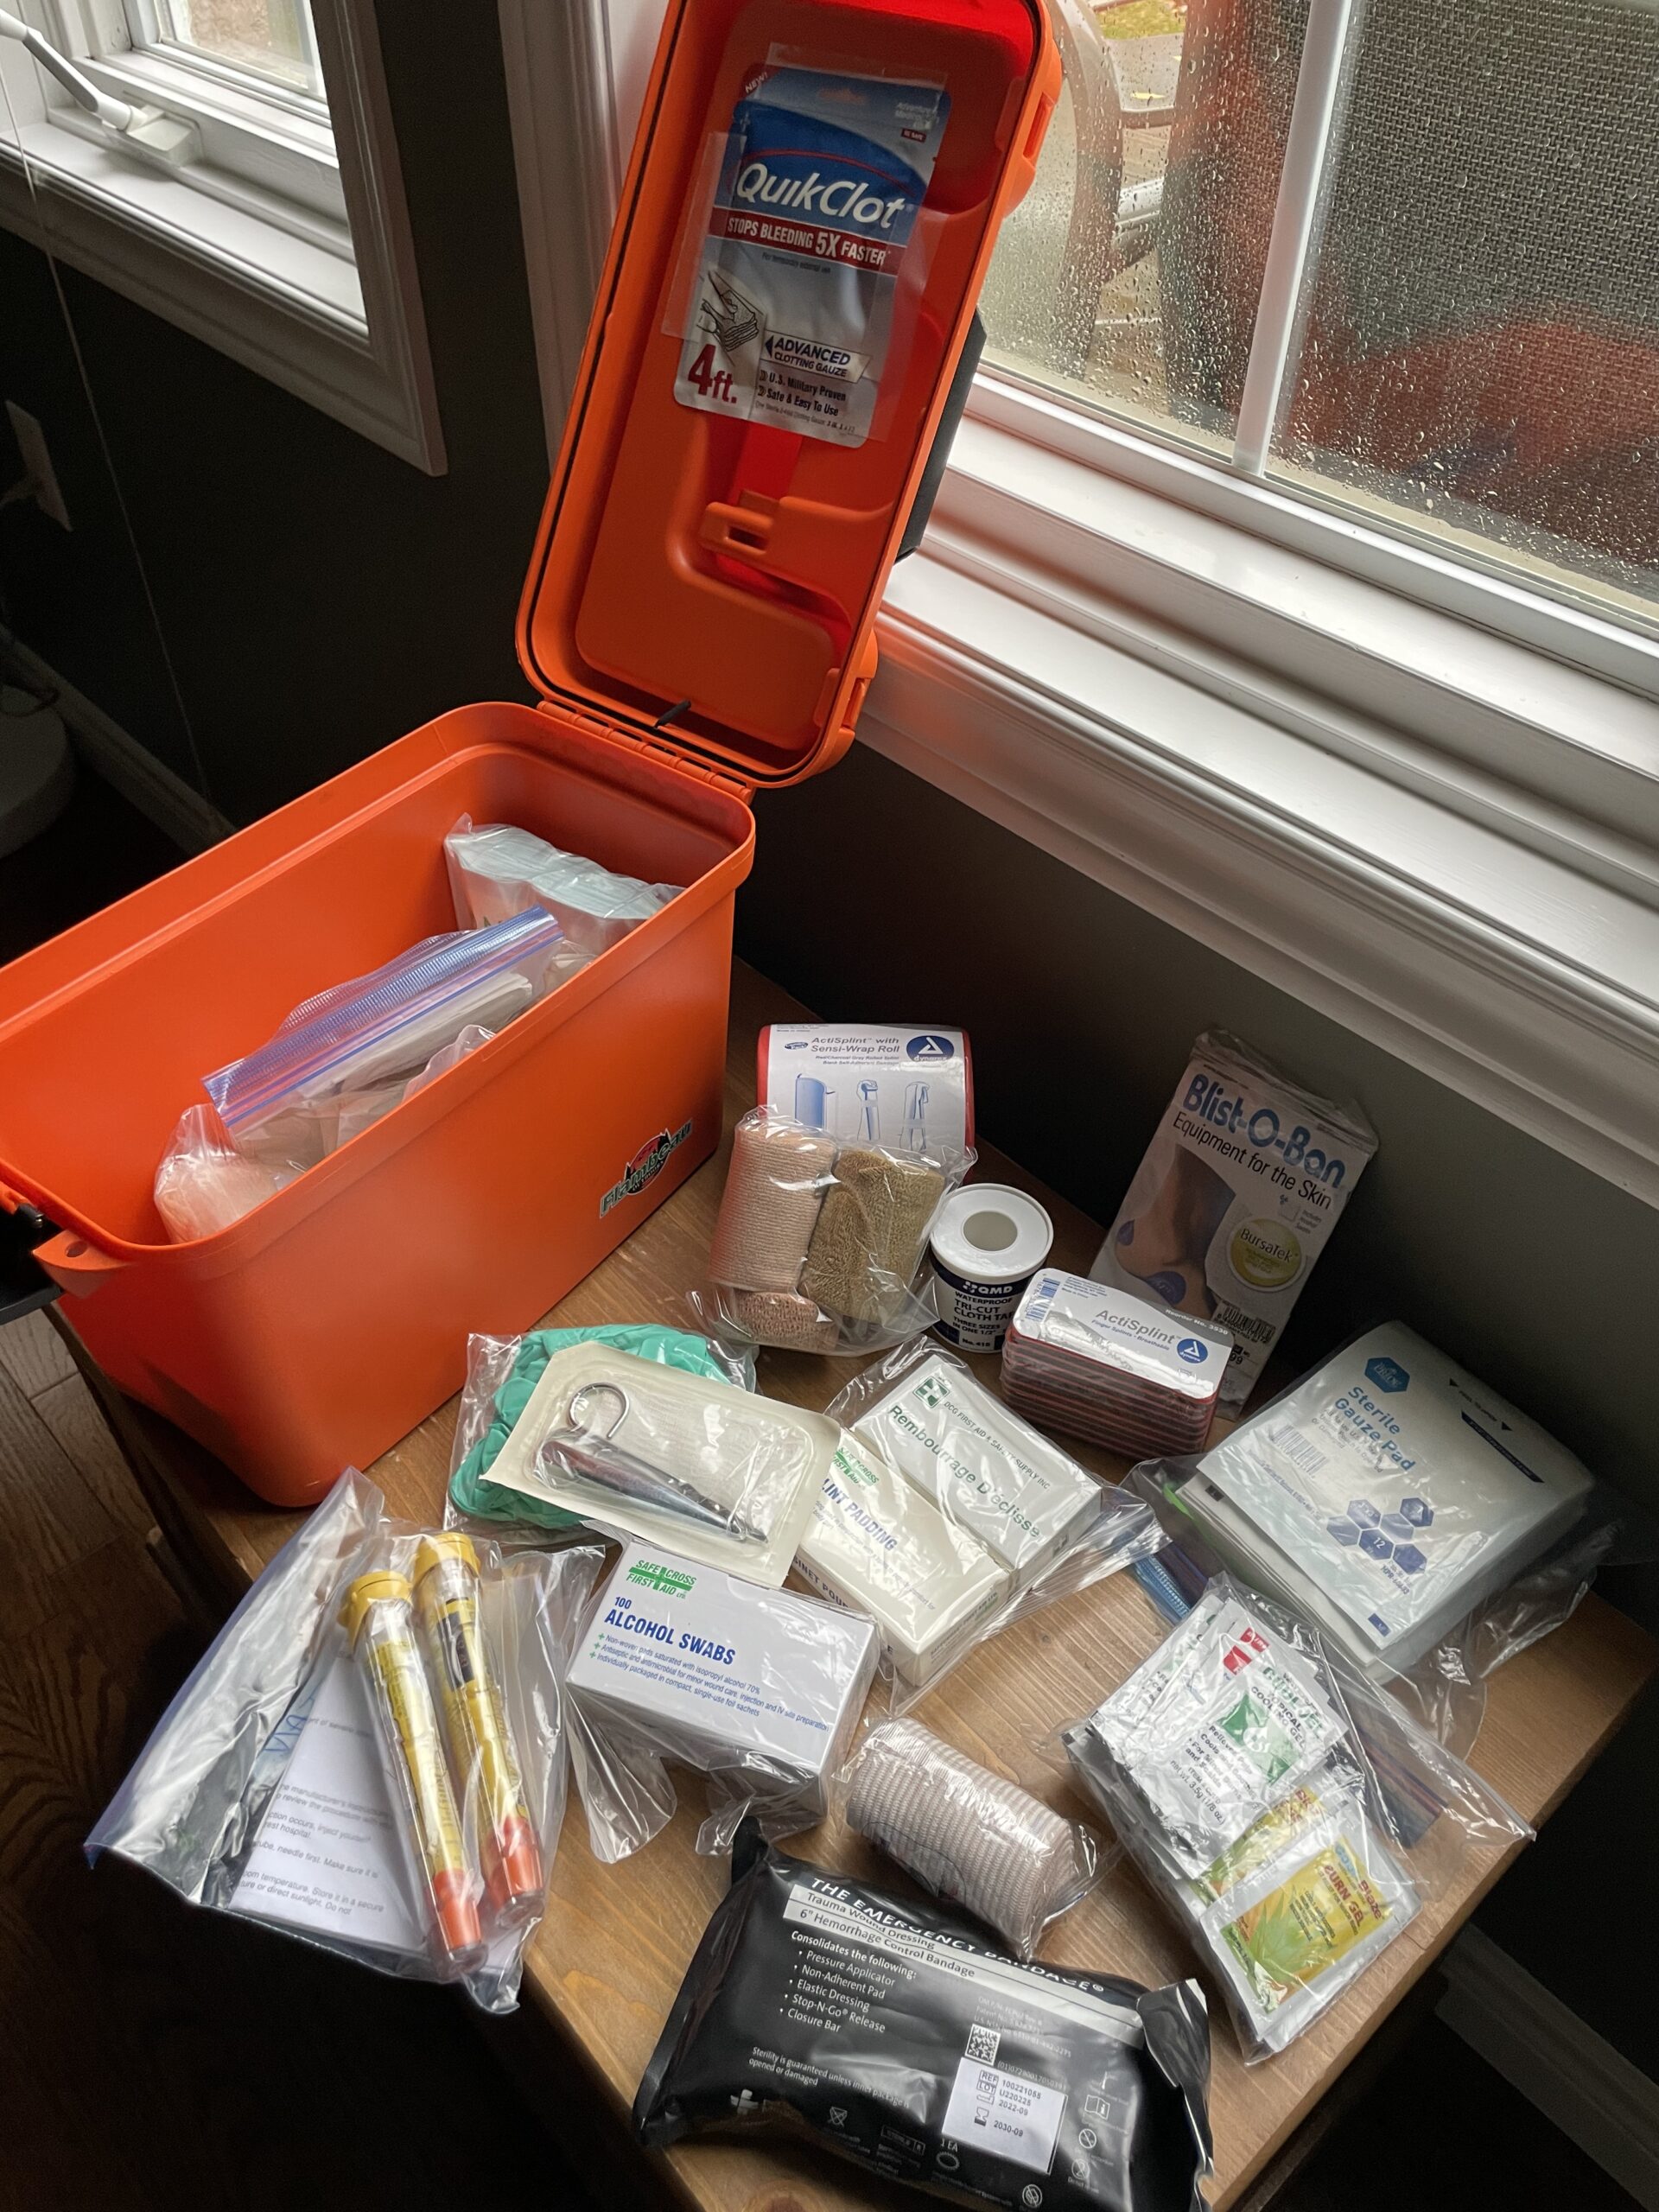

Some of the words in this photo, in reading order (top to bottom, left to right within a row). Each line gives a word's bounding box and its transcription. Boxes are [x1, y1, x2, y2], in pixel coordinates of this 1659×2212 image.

[745, 72, 767, 93] NEW!
[737, 163, 906, 228] QuikClot
[728, 218, 758, 236] STOPS
[760, 226, 814, 248] BLEEDING
[816, 232, 841, 257] 5X
[774, 338, 850, 365] ADVANCED
[774, 352, 814, 370] CLOTTING
[816, 363, 848, 378] GAUZE
[769, 373, 785, 385] U.S.
[788, 378, 817, 395] Military
[820, 385, 846, 401] Proven
[766, 389, 784, 403] Safe
[785, 392, 792, 404] &
[795, 395, 811, 410] Easy
[814, 401, 822, 411] To
[824, 404, 839, 416] Use
[1183, 1073, 1346, 1189] Blist-O-Ban
[601, 1120, 691, 1217] Flambeau
[1173, 1111, 1248, 1164] Equipment
[1247, 1154, 1271, 1175] for
[1270, 1166, 1296, 1190] the
[1298, 1180, 1332, 1210] Skin
[1240, 1228, 1293, 1262] BursaTek
[955, 1291, 1012, 1305] WATERPROOF
[978, 1286, 1013, 1294] QMD
[954, 1306, 991, 1320] CLOTH
[955, 1299, 1000, 1313] TRI-CUT
[954, 1316, 976, 1327] THREE
[1091, 1319, 1111, 1332] Finger
[1348, 1387, 1400, 1434] Sterile
[882, 1403, 982, 1487] Rembourrage
[942, 1400, 959, 1415] DCG
[956, 1411, 976, 1430] FIRST
[973, 1425, 988, 1439] AID
[1013, 1458, 1039, 1481] SUPPLY
[1334, 1398, 1381, 1441] Gauze
[1382, 1440, 1416, 1471] Pad
[846, 1471, 861, 1484] AID
[841, 1500, 900, 1553] PADDING
[1371, 1535, 1386, 1550] 12
[626, 1572, 654, 1588] FIRST
[658, 1583, 677, 1595] AID
[635, 1559, 661, 1573] SAFE
[664, 1568, 696, 1586] CROSS
[613, 1595, 632, 1610] 100
[603, 1607, 677, 1644] ALCOHOL
[677, 1631, 736, 1666] SWABS
[605, 1634, 639, 1651] Non-woven
[638, 1645, 654, 1656] pads
[653, 1650, 682, 1666] saturated
[682, 1660, 696, 1670] with
[695, 1664, 724, 1682] isopropyl
[722, 1675, 746, 1689] alcohol
[746, 1683, 761, 1694] 70%
[595, 1652, 629, 1670] Individually
[628, 1664, 658, 1681] packaged
[692, 1688, 725, 1705] single-use
[724, 1698, 736, 1707] foil
[735, 1702, 760, 1717] sachets
[600, 1643, 629, 1659] Antiseptic
[628, 1653, 640, 1662] and
[639, 1657, 677, 1675] antimicrobial
[685, 1673, 703, 1684] minor
[702, 1680, 724, 1693] wound
[739, 1693, 765, 1707] injection
[764, 1702, 777, 1712] and
[795, 1713, 830, 1732] preparation
[1185, 1745, 1200, 1764] and
[1191, 1740, 1205, 1756] For
[1199, 1732, 1220, 1756] Cools
[1186, 1765, 1203, 1783] ITEM
[282, 1794, 308, 1806] review
[308, 1800, 321, 1809] the
[279, 1824, 312, 1840] hospital.
[322, 1857, 345, 1870] Make
[346, 1865, 364, 1875] sure
[266, 1885, 289, 1898] direct
[324, 1901, 337, 1911] Do
[338, 1905, 352, 1916] not
[311, 1886, 334, 1899] Store
[341, 1894, 350, 1904] in
[810, 1877, 851, 1902] THE
[805, 1891, 847, 1914] Trauma
[846, 1908, 888, 1932] Wound
[887, 1926, 936, 1953] Dressing
[791, 1929, 850, 1955] Consolidates
[850, 1948, 868, 1961] the
[867, 1954, 918, 1980] following:
[799, 1907, 814, 1921] 6"
[812, 1912, 883, 1945] Hemorrhage
[882, 1938, 925, 1959] Control
[925, 1953, 976, 1978] Bandage
[800, 1964, 868, 1993] Non-Adherent
[867, 1985, 886, 1999] Pad
[805, 1950, 845, 1970] Pressure
[845, 1962, 896, 1987] Applicator
[796, 1978, 828, 1997] Elastic
[827, 1988, 871, 2013] Dressing
[786, 2007, 823, 2027] Closure
[823, 2019, 842, 2032] Bar
[848, 2012, 887, 2032] Release
[747, 2056, 776, 2075] opened
[774, 2065, 784, 2075] or
[782, 2068, 819, 2088] damaged
[751, 2045, 780, 2063] Sterility
[779, 2055, 786, 2064] is
[785, 2057, 828, 2079] guaranteed
[827, 2071, 853, 2087] unless
[871, 2088, 904, 2107] package
[981, 2072, 998, 2082] REF
[978, 2082, 995, 2093] LOT
[946, 2140, 959, 2152] EA
